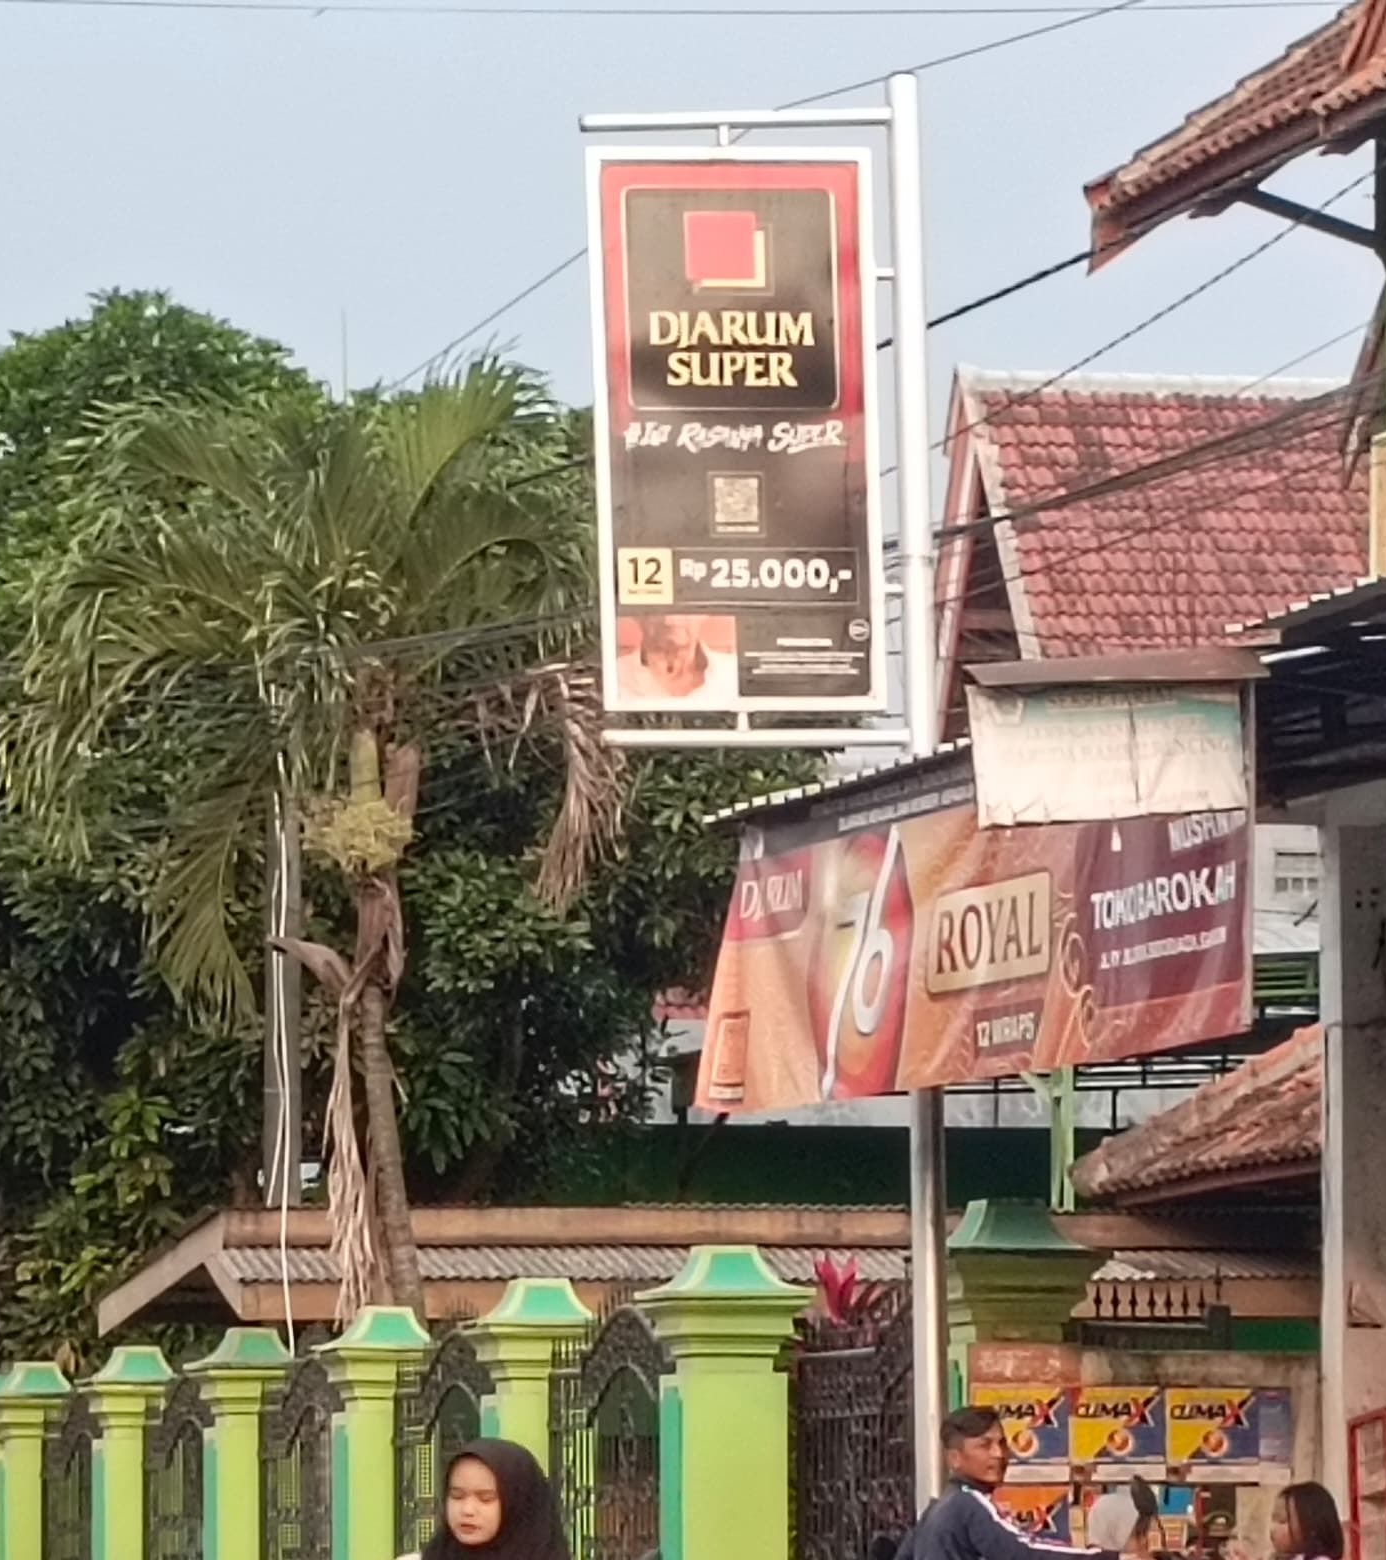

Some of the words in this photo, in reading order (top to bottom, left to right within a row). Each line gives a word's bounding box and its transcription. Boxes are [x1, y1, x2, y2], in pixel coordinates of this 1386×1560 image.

[648, 310, 815, 348] DJARUM
[666, 351, 799, 387] SUPER
[626, 555, 664, 585] 12
[935, 889, 1044, 977] ROYAL
[975, 1021, 991, 1048] 12
[1075, 1389, 1162, 1429] CLIMAX
[1169, 1388, 1255, 1430] CLIMAX
